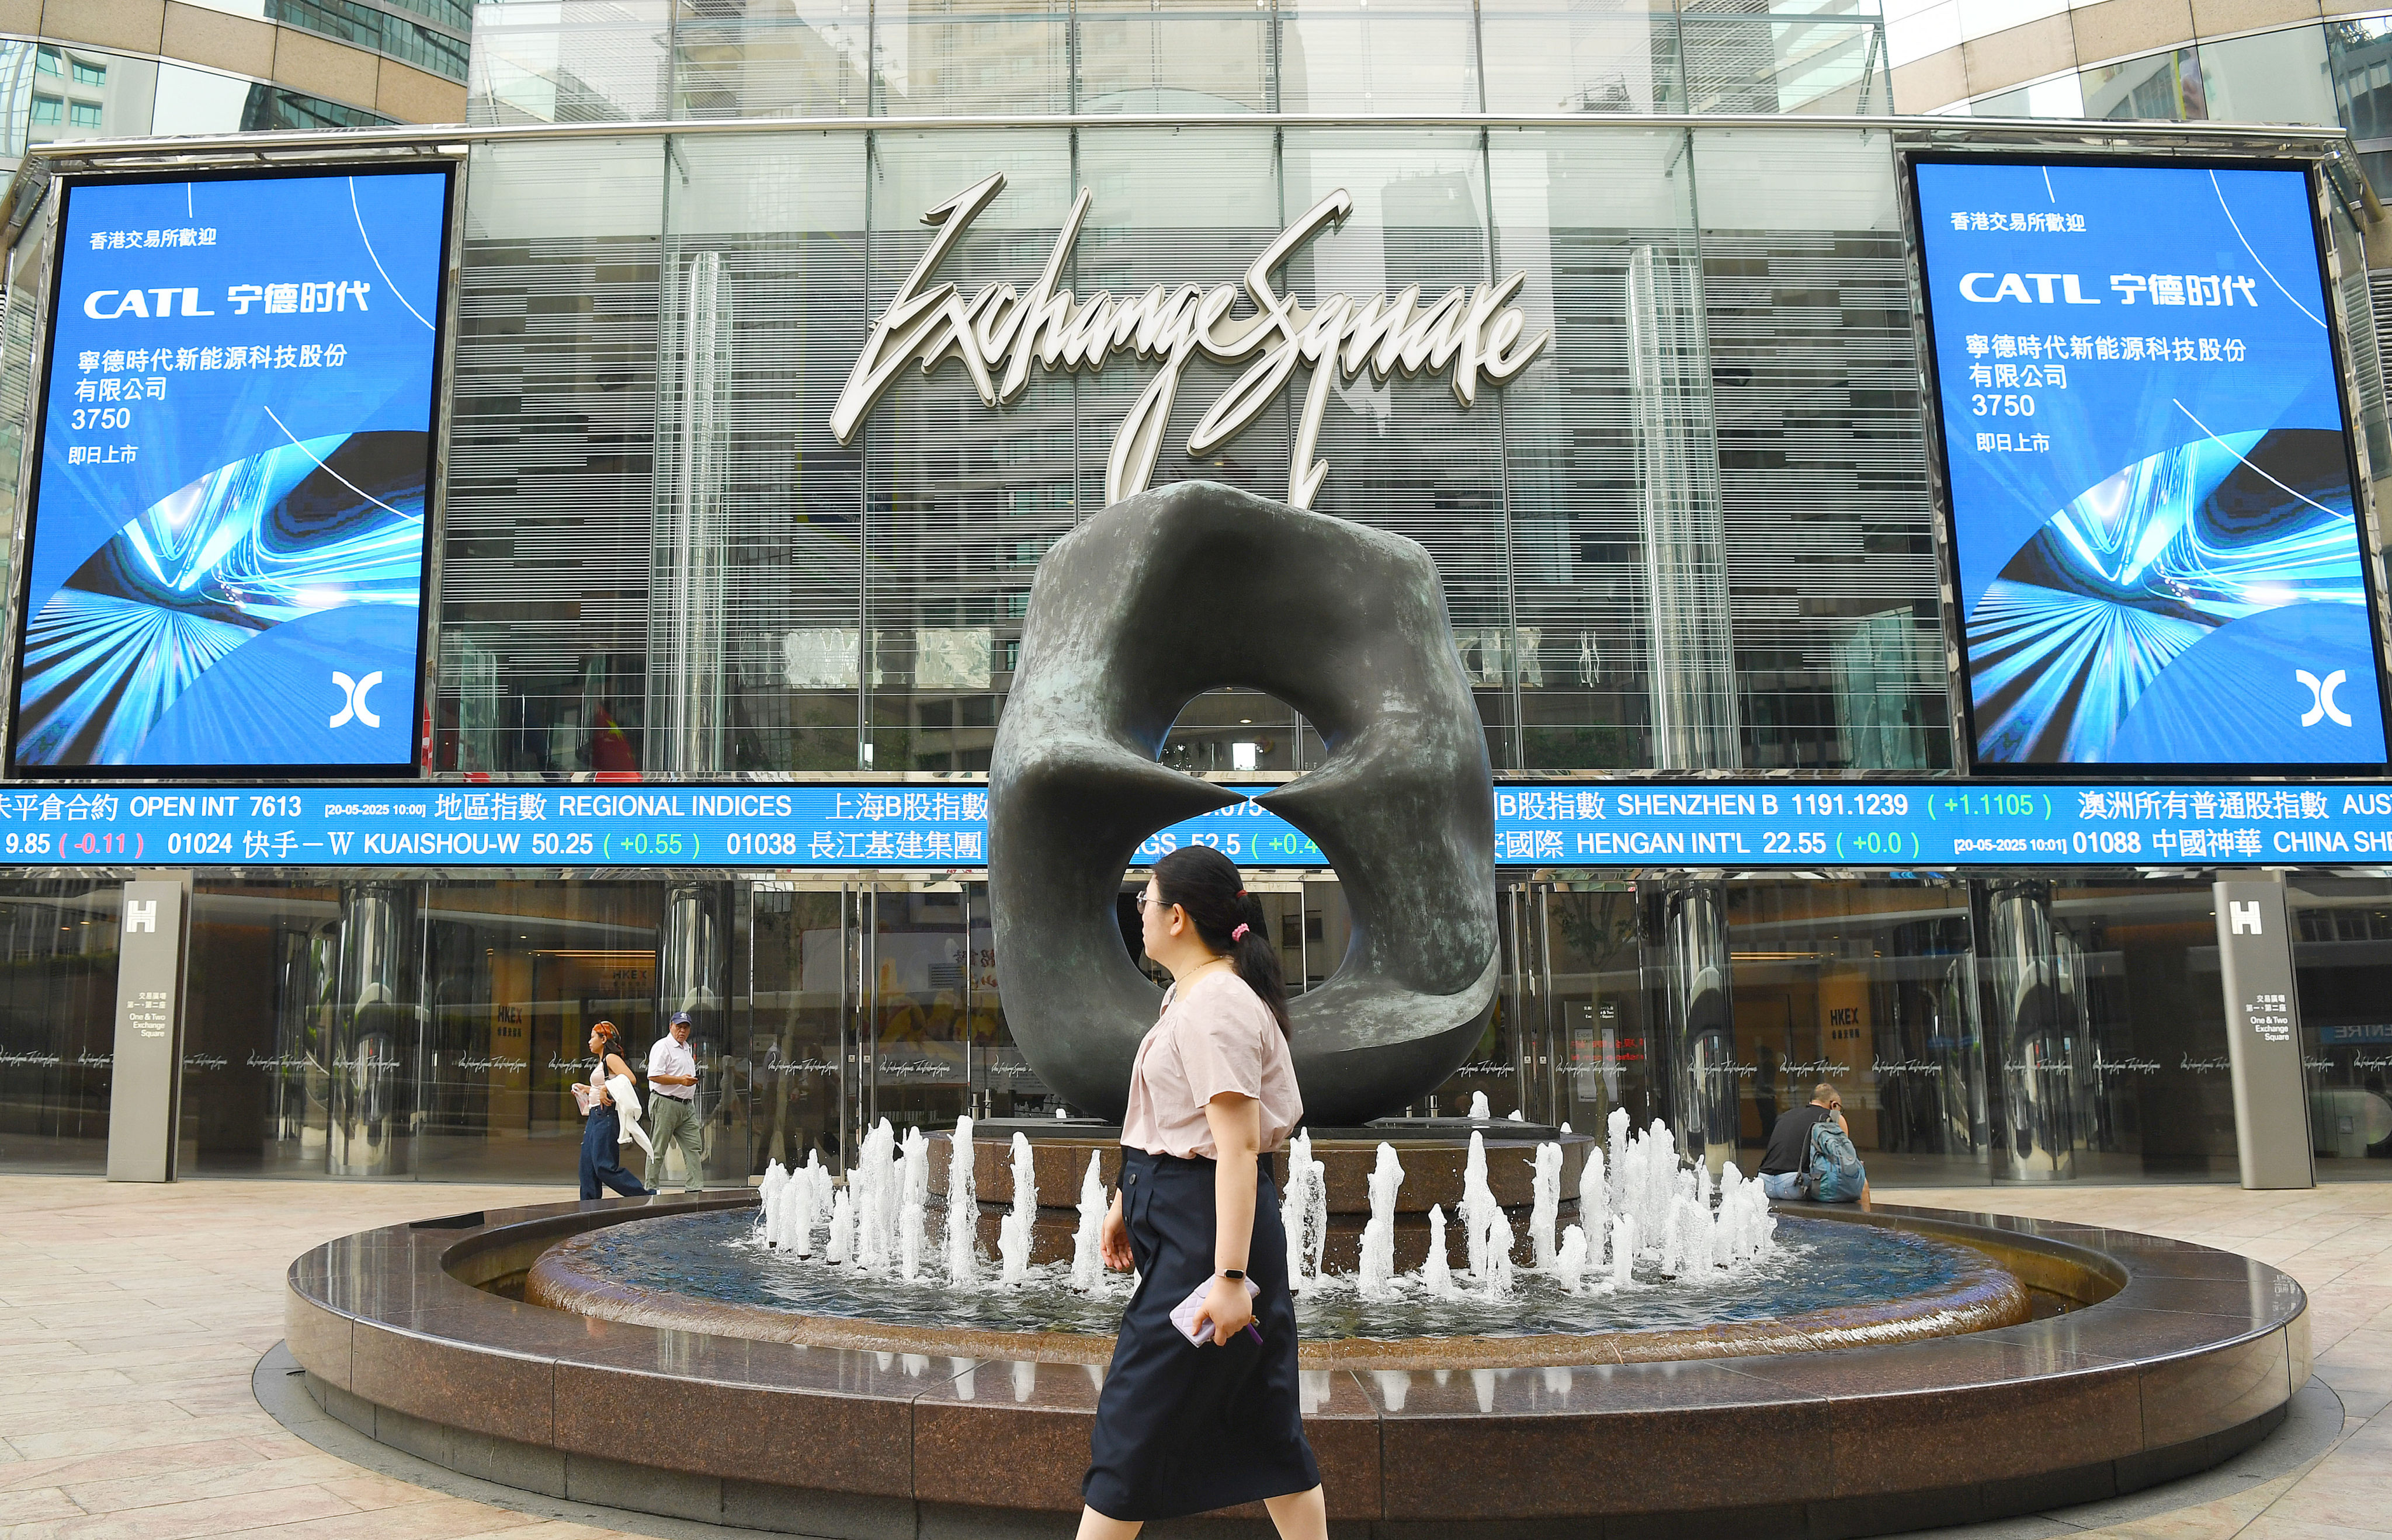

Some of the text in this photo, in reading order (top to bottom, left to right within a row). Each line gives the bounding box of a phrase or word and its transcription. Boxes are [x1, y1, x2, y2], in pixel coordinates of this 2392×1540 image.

[1950, 211, 2087, 232] 香港交易所歡迎
[90, 227, 217, 250] 香港交易所歡迎
[84, 280, 371, 319] CATL 宁德时代
[1959, 272, 2259, 307] CATL 宁德时代
[830, 171, 1549, 510] Exchange Square
[1965, 333, 2247, 363] 寧德時代新能源科技股份
[78, 343, 348, 374] 寧德時代新能源科技股份
[1969, 362, 2067, 390] 有限公司
[75, 377, 166, 403] 有限公司
[1972, 394, 2035, 416] 3750
[71, 408, 130, 430] 3750
[68, 444, 138, 465] 即日上市
[1976, 433, 2050, 453] 即日上市
[130, 797, 195, 816] OPEN
[202, 797, 239, 816] INT
[250, 796, 301, 816] 7613
[435, 792, 547, 821] 地區指數
[560, 795, 685, 816] REGIONAL
[693, 795, 791, 816] INDICES
[825, 792, 988, 822] 上海B股指數
[1494, 791, 1606, 820] B股指數
[1618, 794, 1755, 815] SHENZHEN
[1762, 794, 1779, 815] B
[1792, 794, 1908, 815] 1191.1239
[2078, 791, 2329, 820] 澳洲所有普通股指數
[2343, 793, 2392, 815] AUS
[6, 833, 50, 854] 9.85
[168, 833, 232, 854] 01024
[364, 833, 520, 854] KUAISHOU-W
[532, 833, 593, 854] 50.25
[727, 833, 796, 854] 01038
[808, 830, 982, 860] 長江基建集團
[1577, 832, 1684, 854] HENGAN
[1692, 832, 1750, 854] INT'L
[1763, 832, 1826, 853] 22.55
[2073, 832, 2141, 853] 01088
[2153, 829, 2262, 858] 中國神華
[2274, 831, 2349, 853] CHINA
[133, 1021, 165, 1030] Exchange
[498, 1006, 523, 1024] HKEX
[1830, 1007, 1859, 1026] HKEX
[141, 1030, 165, 1038] Square
[2255, 1025, 2289, 1033] Exchange
[2265, 1033, 2289, 1042] Square
